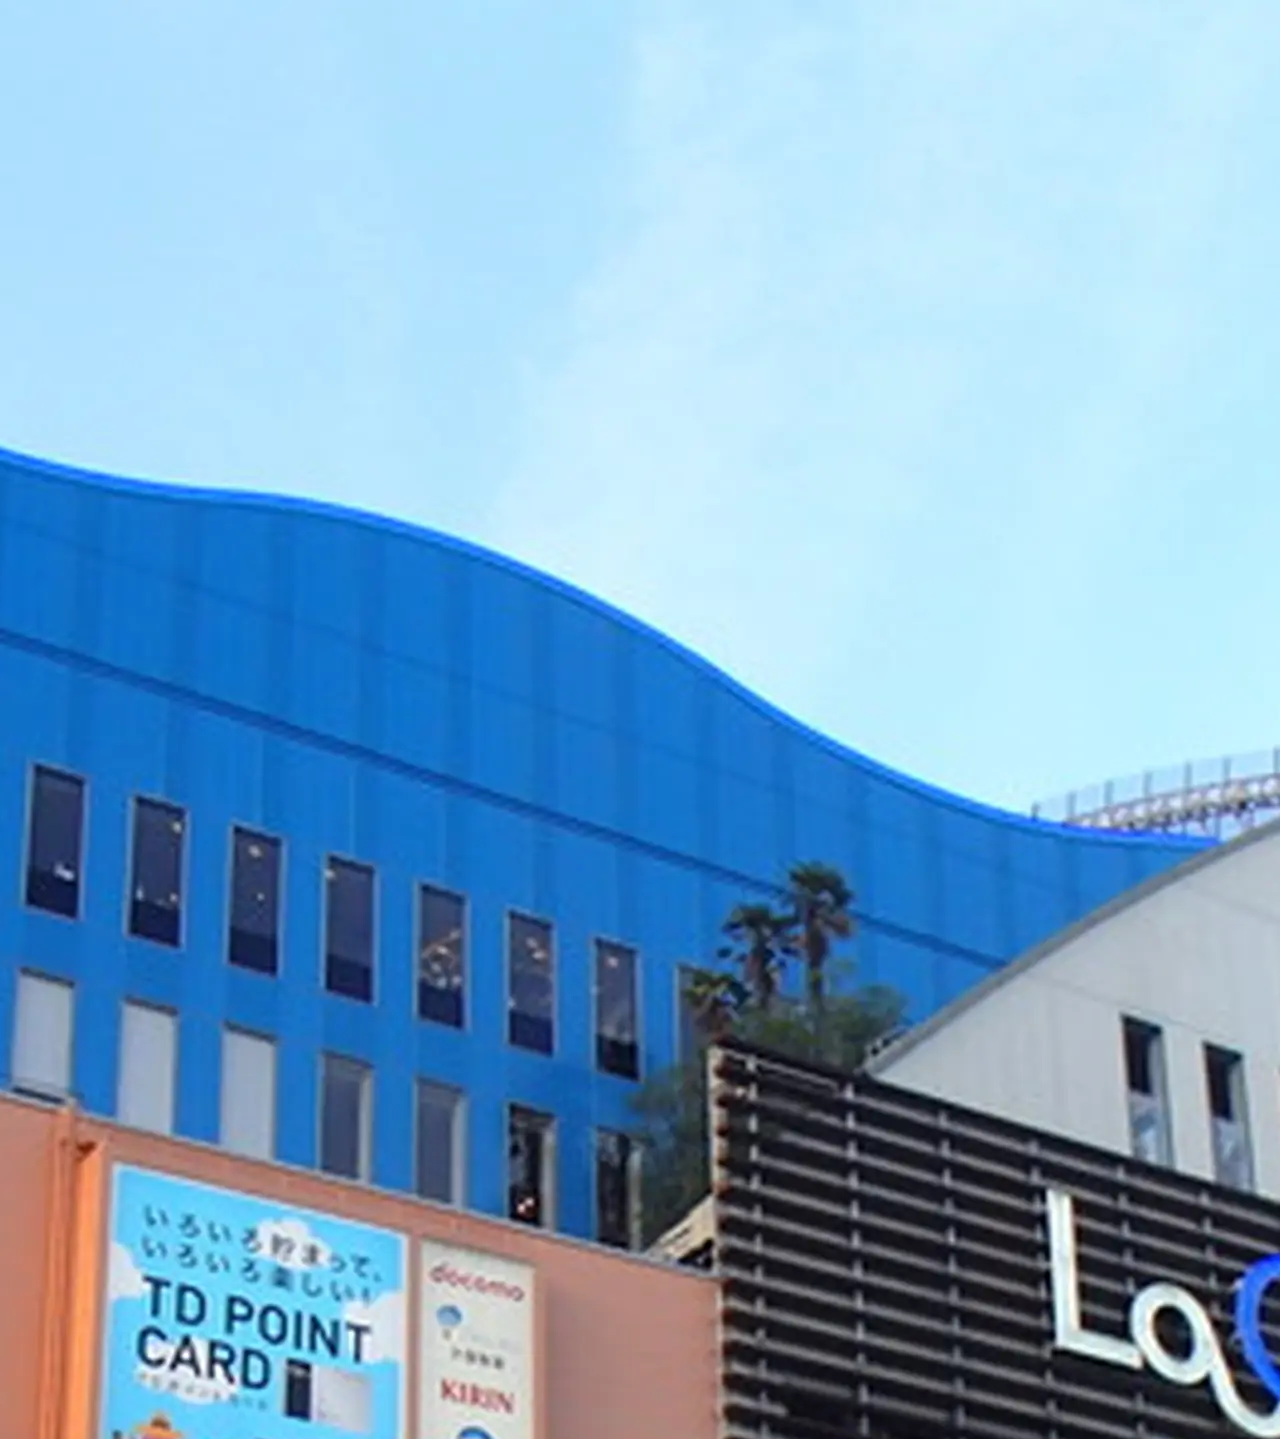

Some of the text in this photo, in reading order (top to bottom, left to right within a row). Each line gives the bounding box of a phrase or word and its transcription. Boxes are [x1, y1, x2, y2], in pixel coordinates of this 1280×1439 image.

[142, 1275, 373, 1364] TD POINT
[136, 1325, 272, 1390] CARD
[441, 1379, 516, 1414] KIRIN
